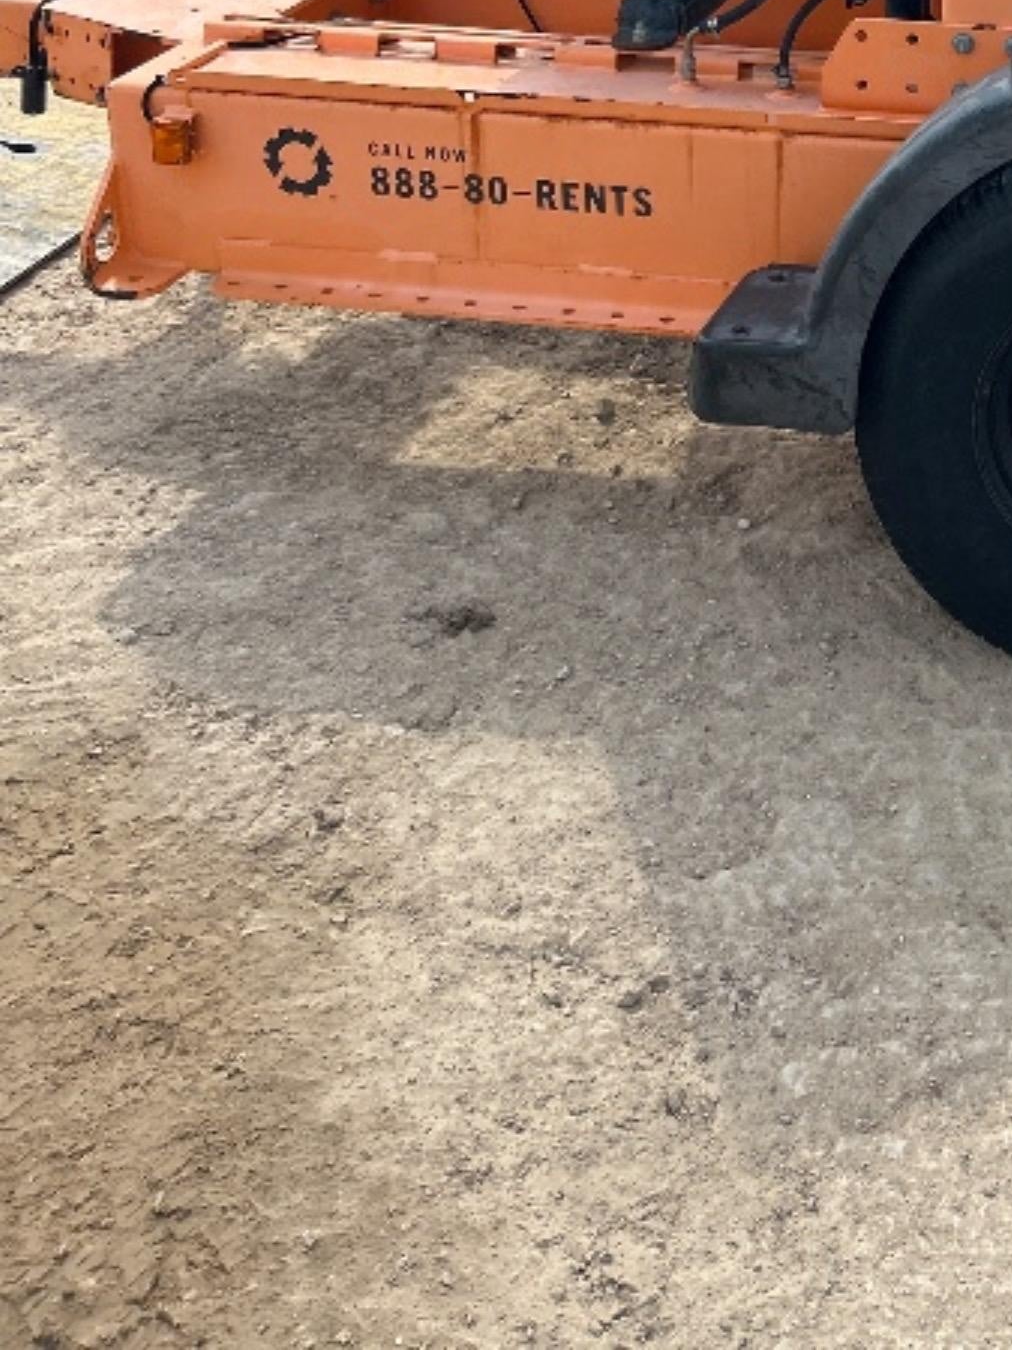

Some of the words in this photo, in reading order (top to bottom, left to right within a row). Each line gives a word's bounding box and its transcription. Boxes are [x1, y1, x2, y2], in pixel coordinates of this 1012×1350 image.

[368, 142, 415, 160] CALL
[425, 145, 467, 163] NOW
[371, 166, 653, 217] 888-80-RENTS
